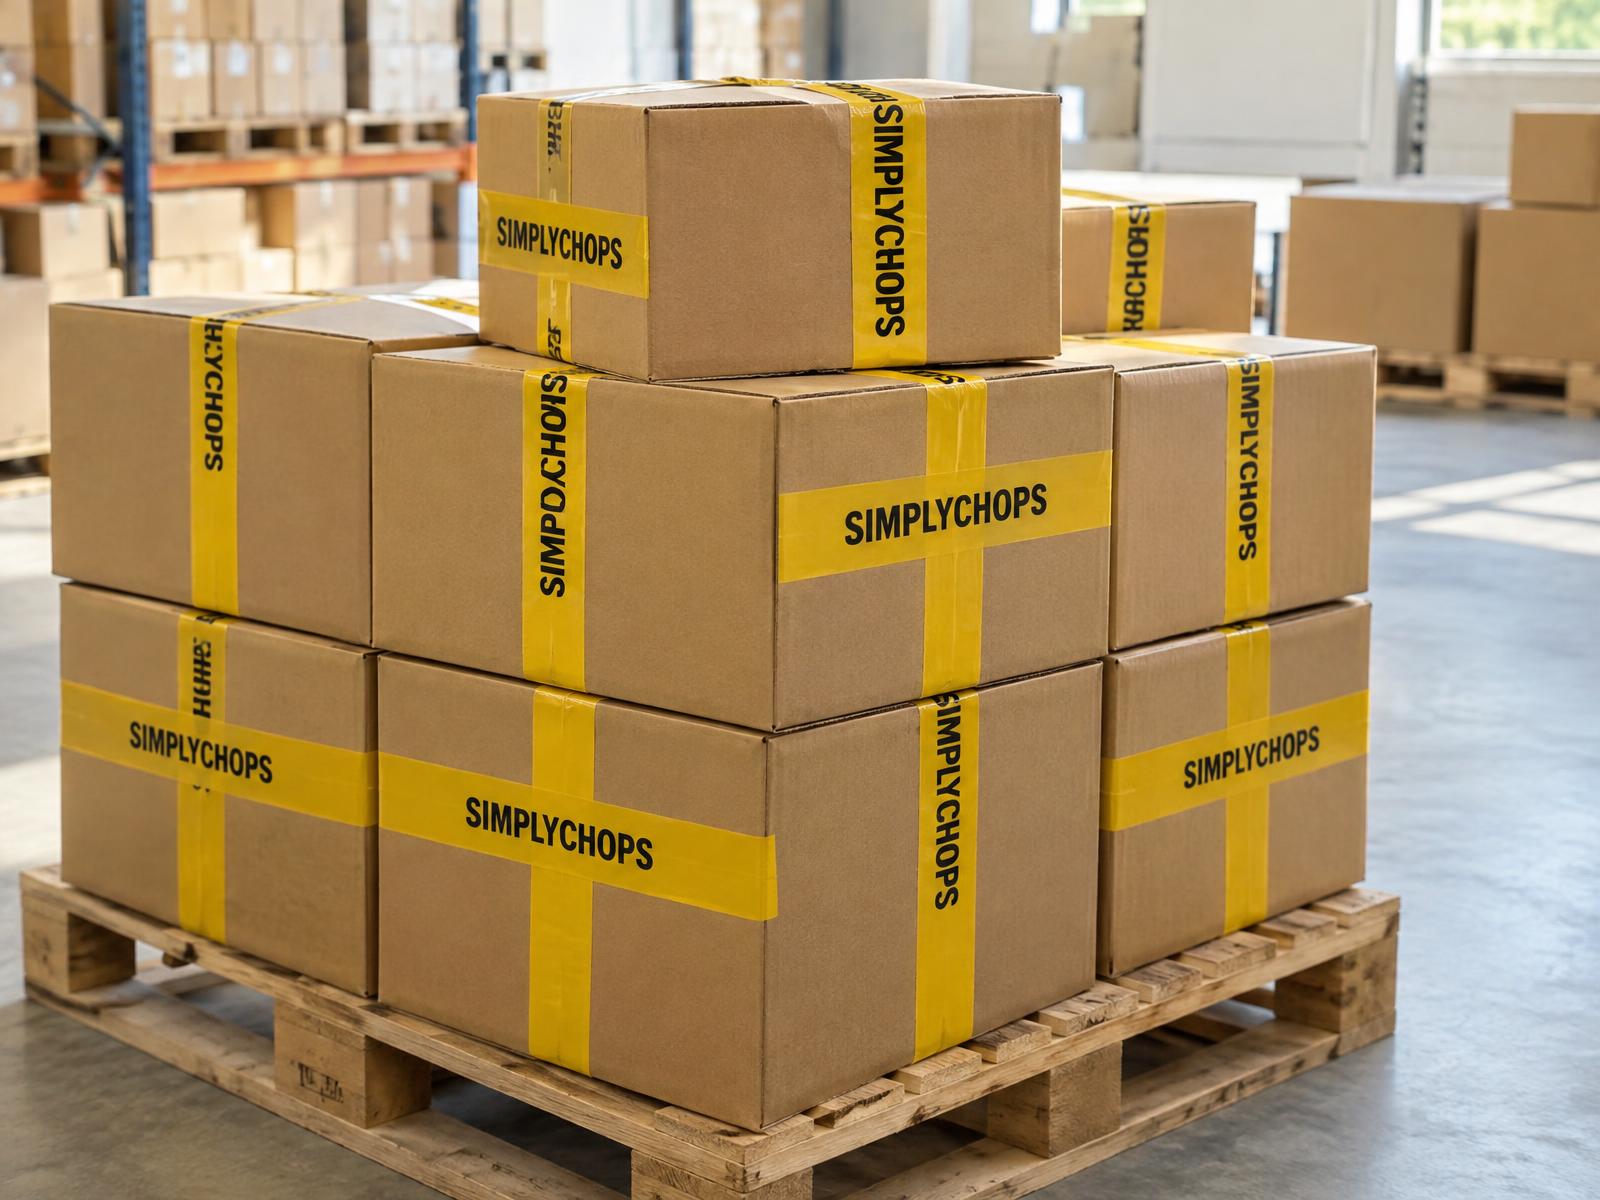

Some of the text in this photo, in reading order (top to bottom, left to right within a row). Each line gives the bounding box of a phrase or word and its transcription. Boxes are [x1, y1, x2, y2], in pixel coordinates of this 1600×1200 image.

[497, 216, 622, 269] SIMPLYCHOPS
[873, 104, 905, 337] SIMPLYCHOPS
[1238, 358, 1260, 561] SIMPLYCHOPS
[845, 484, 1047, 545] SIMPLYCHOPS
[130, 721, 272, 783] SIMPLYCHOPS
[1184, 726, 1320, 789] SIMPLYCHOPS
[466, 797, 653, 870] SIMPLYCHOPS
